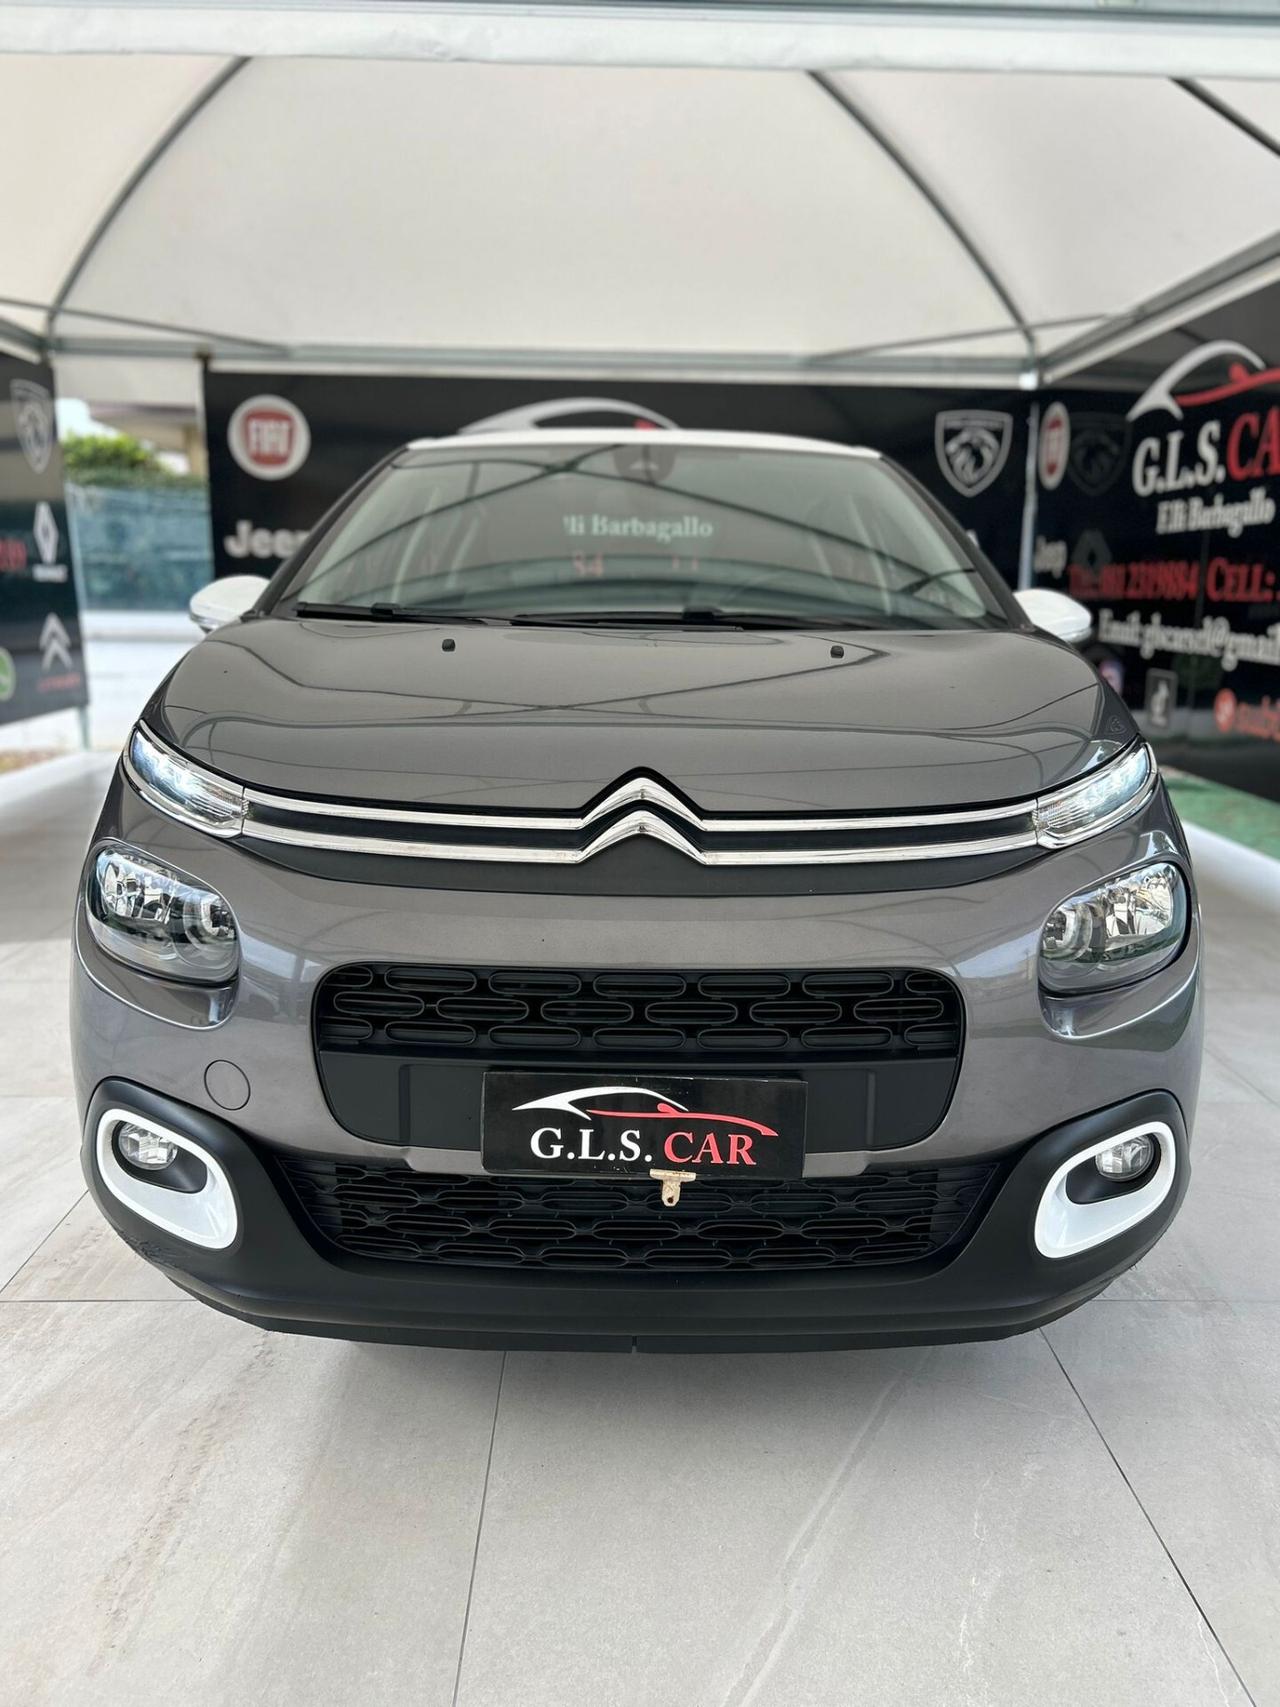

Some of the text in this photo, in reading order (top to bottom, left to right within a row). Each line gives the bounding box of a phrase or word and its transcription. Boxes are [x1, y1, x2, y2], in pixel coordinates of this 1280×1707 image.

[1132, 419, 1226, 497] G.L.S.
[591, 513, 714, 543] Barbagallo
[530, 1127, 757, 1165] G.L.S. CAR
